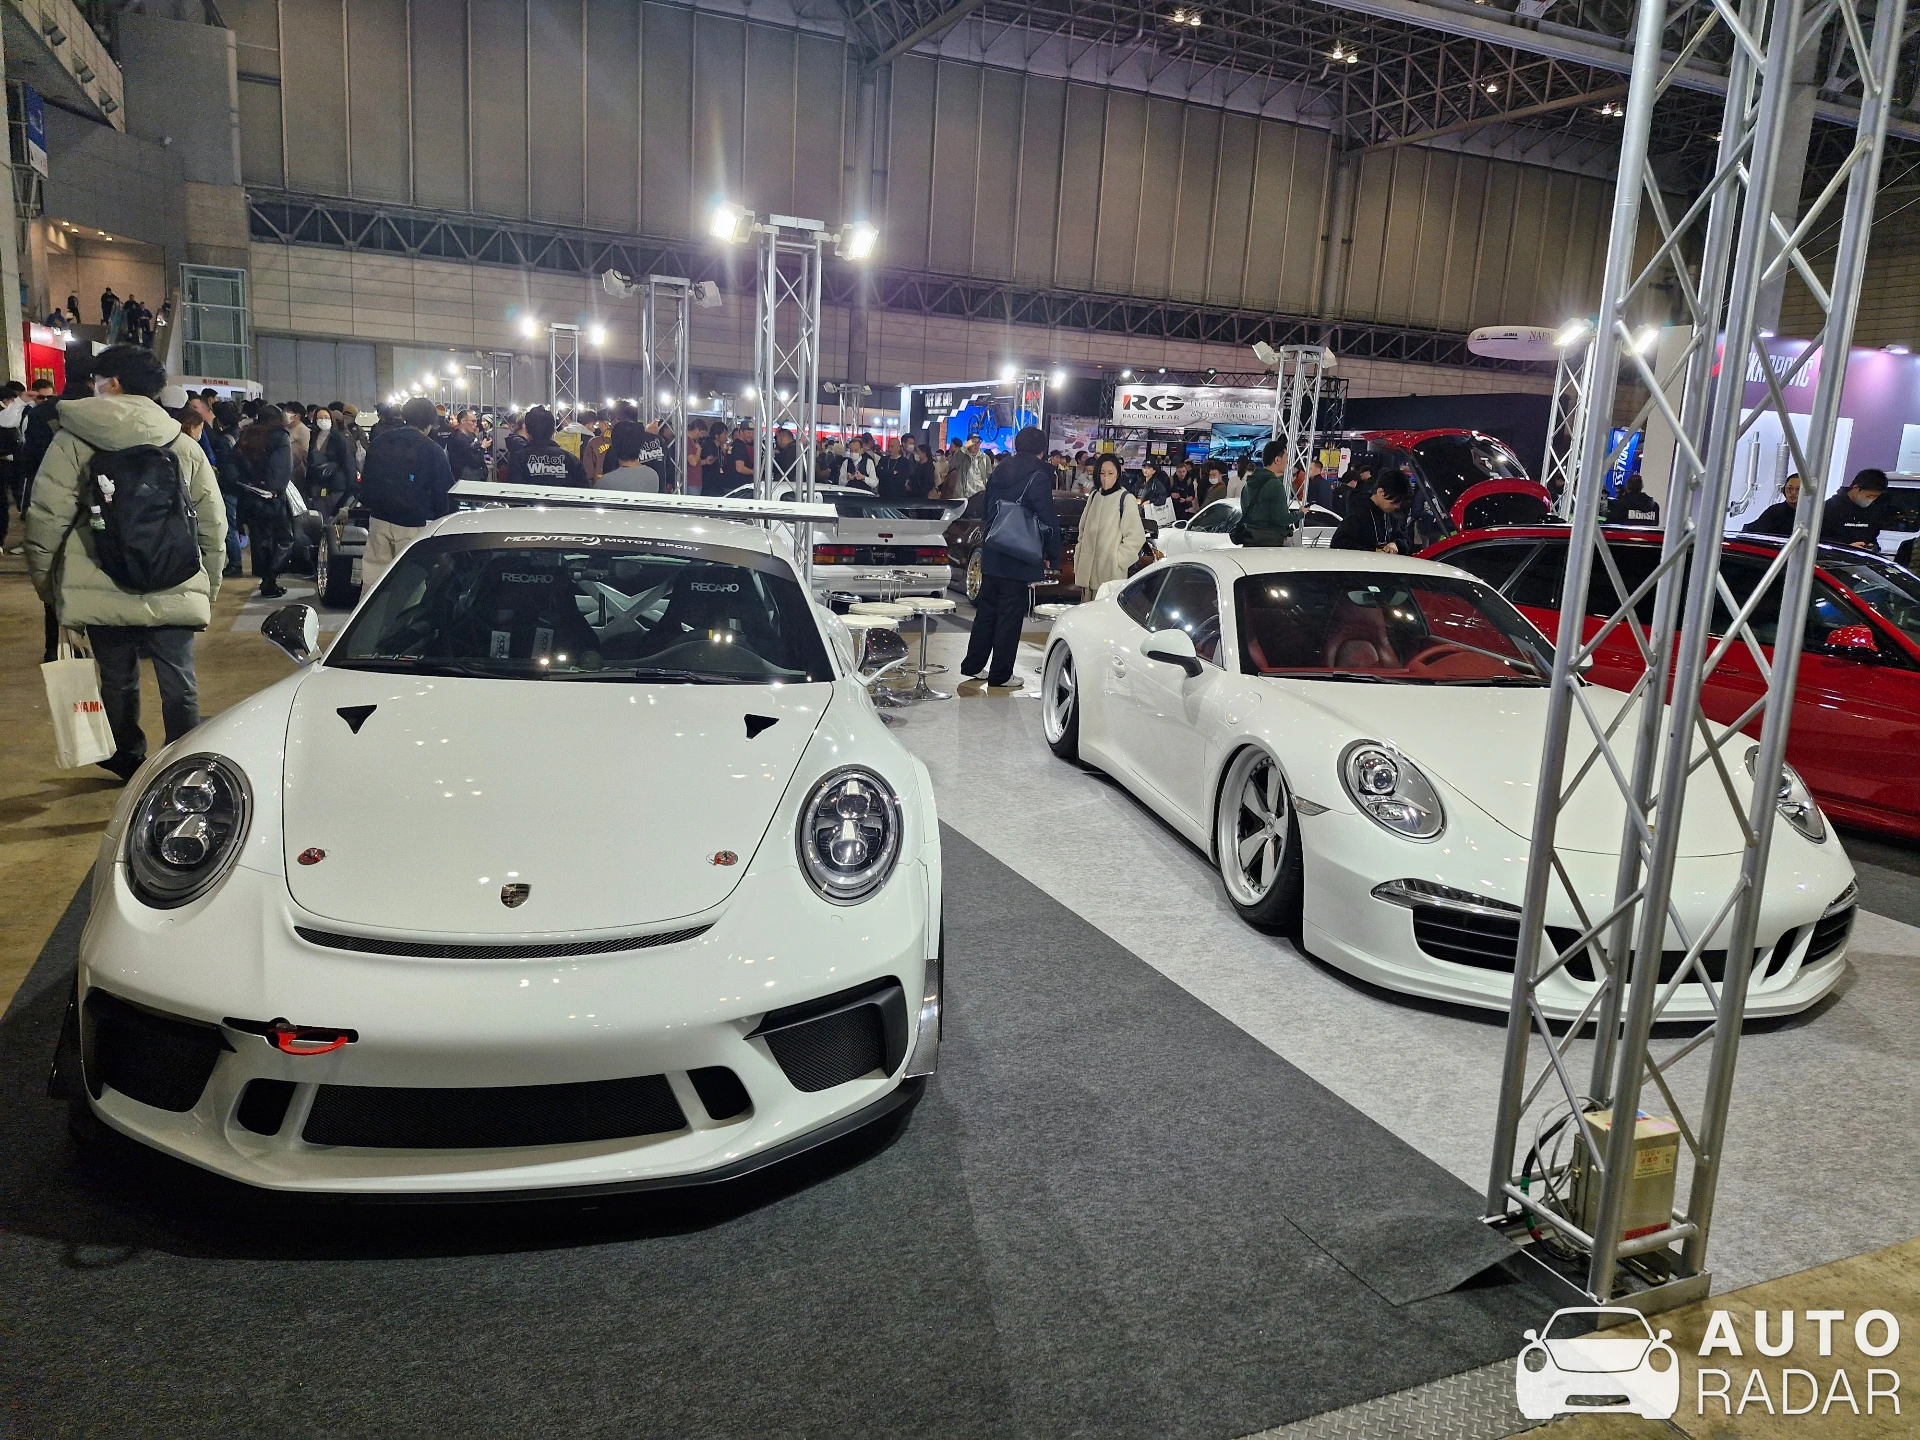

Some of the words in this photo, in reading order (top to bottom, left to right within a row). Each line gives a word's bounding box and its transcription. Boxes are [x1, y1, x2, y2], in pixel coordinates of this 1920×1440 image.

[1122, 394, 1185, 411] RG
[528, 454, 550, 465] Art
[550, 454, 566, 465] of
[504, 535, 597, 545] MOONTECH
[604, 537, 653, 546] MOTOR
[656, 541, 701, 552] SPORT
[501, 572, 554, 584] RECARO
[690, 582, 740, 593] RECARO
